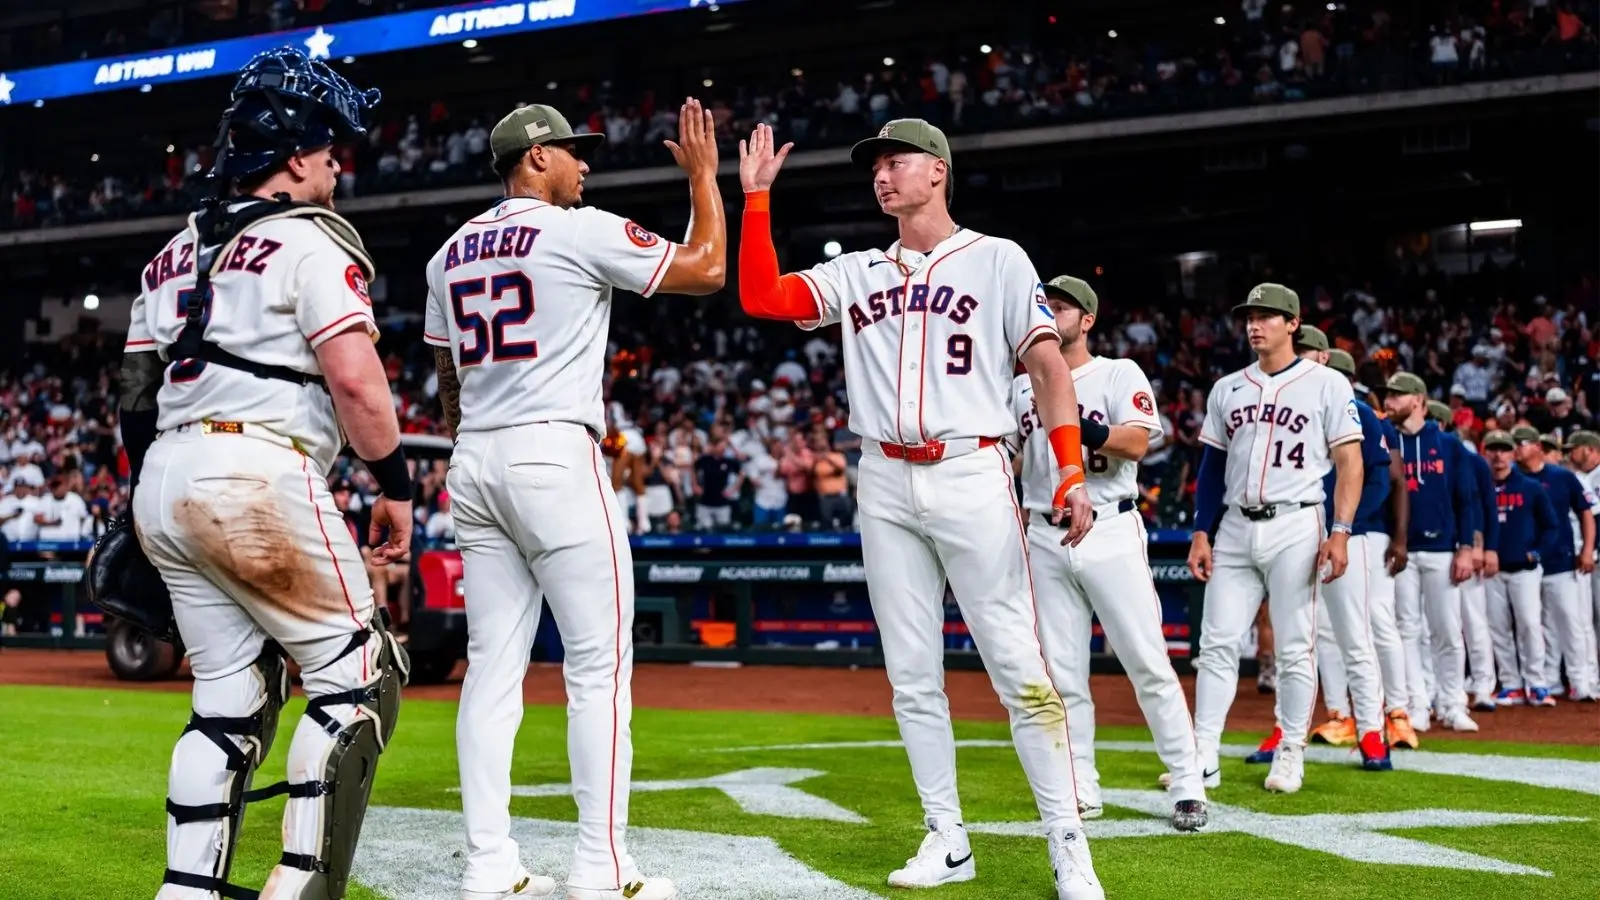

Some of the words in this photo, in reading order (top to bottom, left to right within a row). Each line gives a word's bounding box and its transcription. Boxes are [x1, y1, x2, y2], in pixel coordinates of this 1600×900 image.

[429, 3, 525, 36] ASTROS
[529, 0, 577, 22] WIN
[94, 55, 174, 85] ASTROS
[176, 48, 216, 73] WIN
[444, 225, 541, 272] ABREU
[449, 270, 538, 368] 52
[848, 284, 979, 335] ASTROS
[946, 334, 973, 375] 9
[1271, 440, 1305, 470] 14
